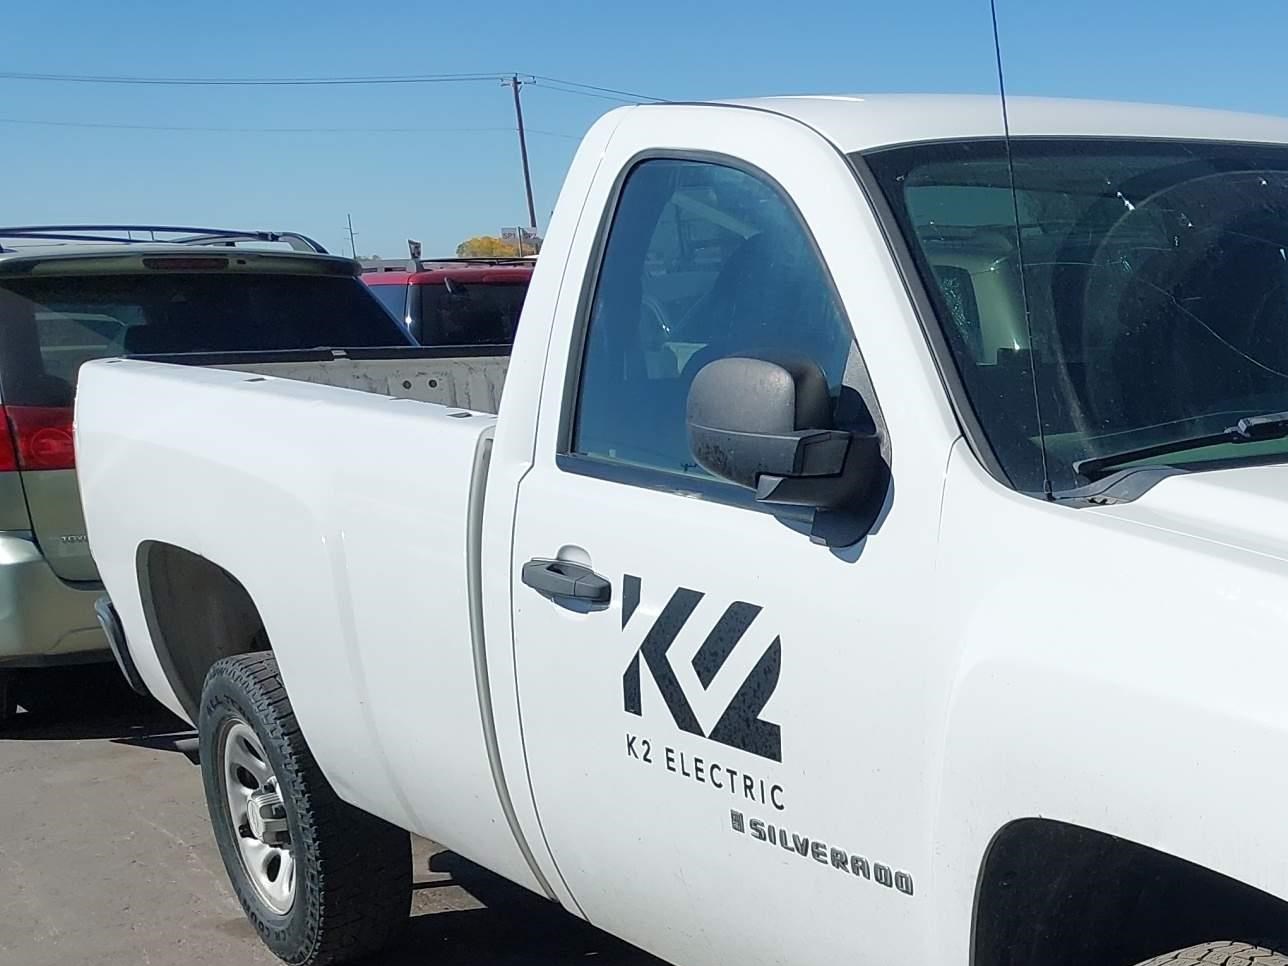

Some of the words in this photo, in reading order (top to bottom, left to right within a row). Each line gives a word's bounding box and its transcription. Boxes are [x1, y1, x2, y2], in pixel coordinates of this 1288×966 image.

[626, 733, 653, 764] K2
[665, 746, 785, 811] ELECTRIC
[749, 817, 914, 896] SILVERADO
